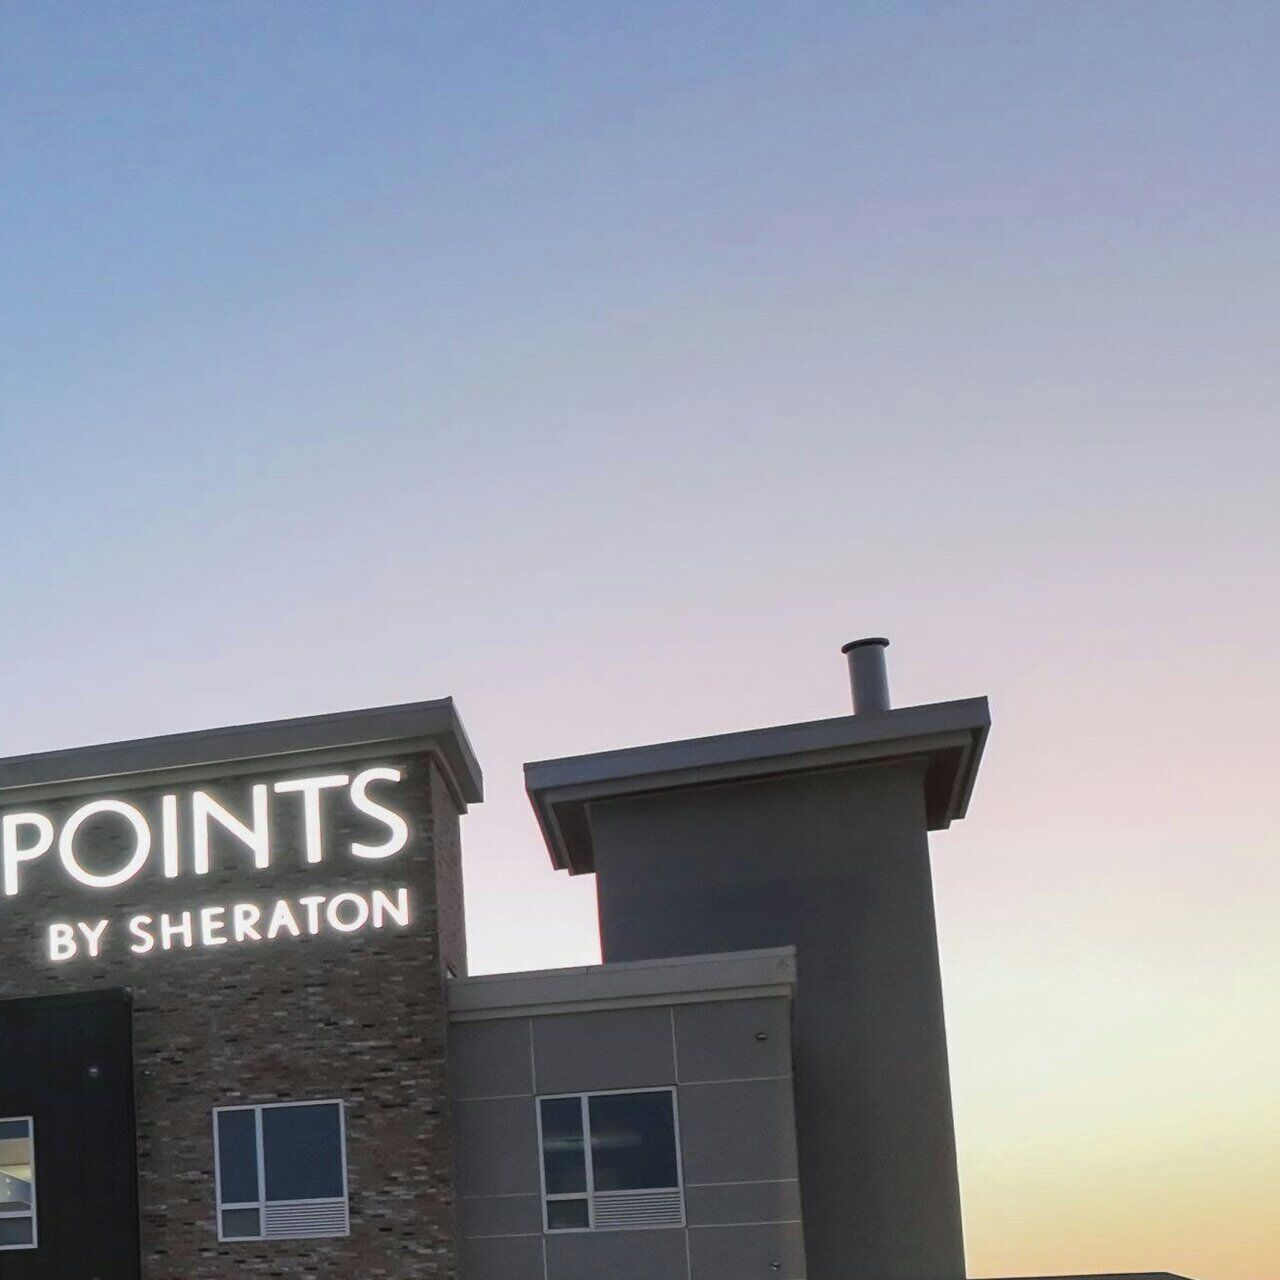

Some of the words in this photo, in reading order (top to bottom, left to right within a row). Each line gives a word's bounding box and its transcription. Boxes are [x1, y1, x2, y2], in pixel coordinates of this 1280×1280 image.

[2, 767, 410, 896] POINTS
[48, 919, 109, 962] BY
[129, 887, 410, 954] SHERATON
